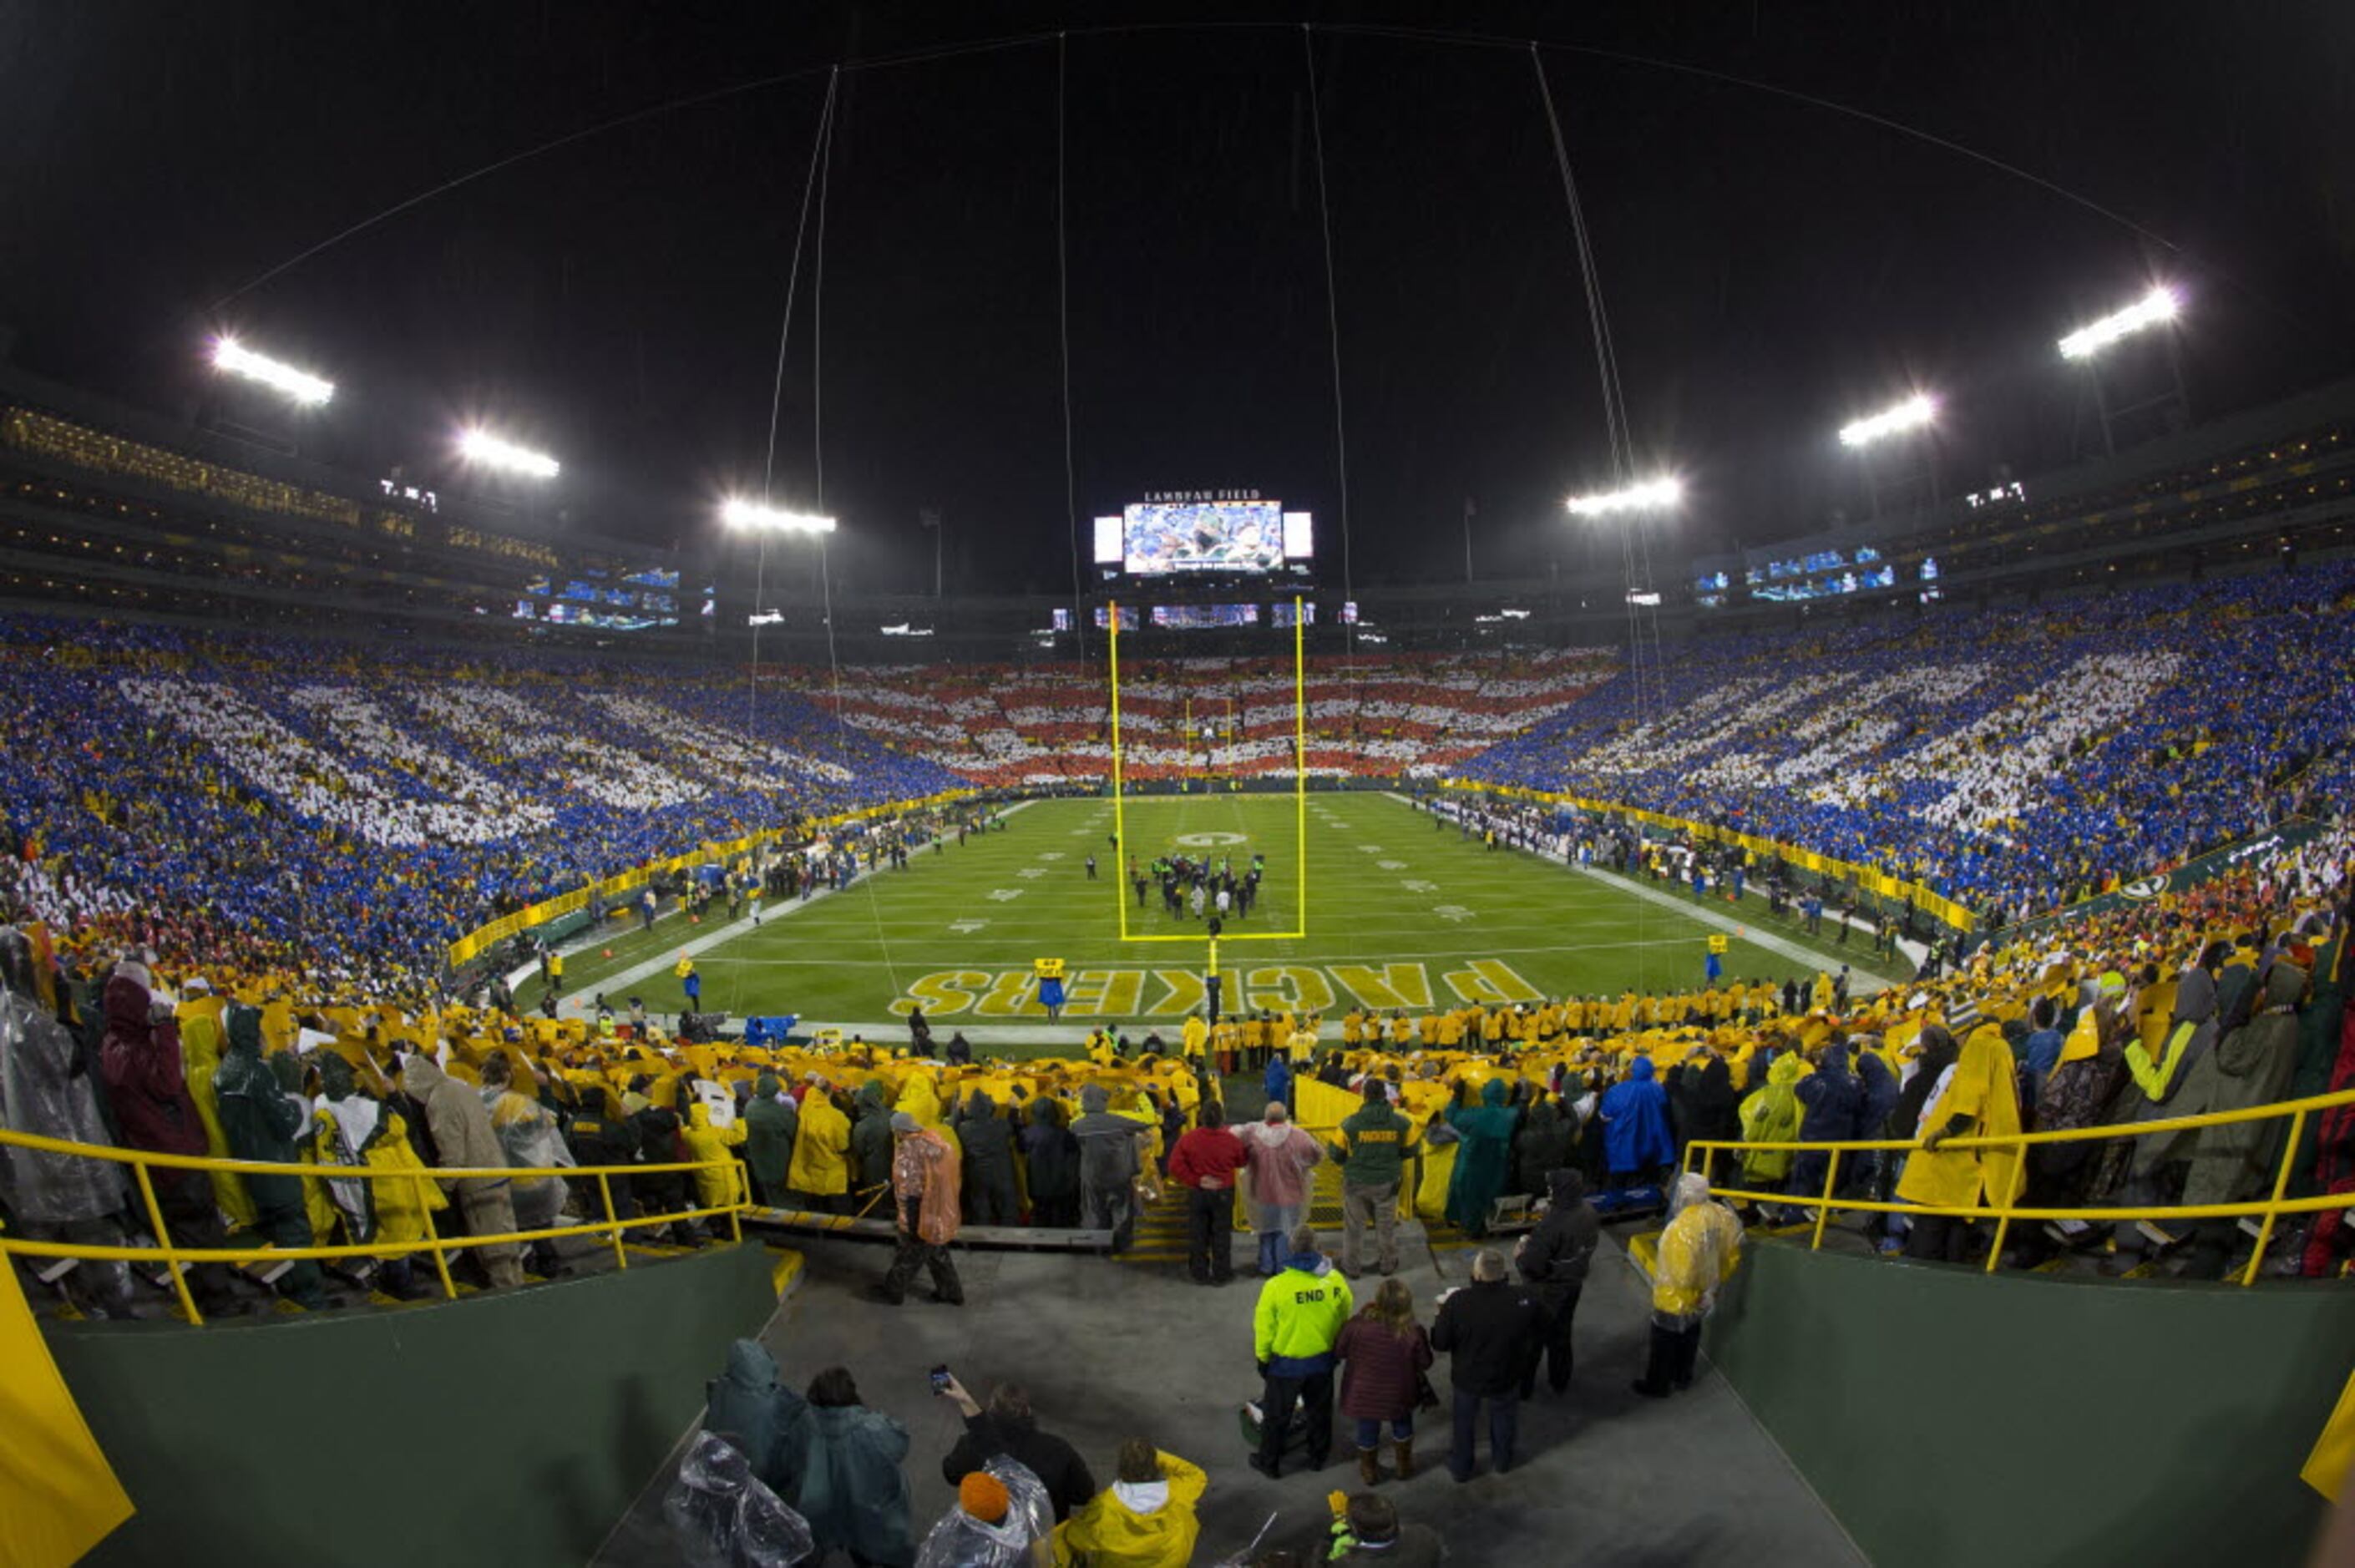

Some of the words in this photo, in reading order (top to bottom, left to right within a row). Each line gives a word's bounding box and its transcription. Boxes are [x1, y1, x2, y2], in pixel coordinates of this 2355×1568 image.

[1144, 491, 1213, 503] LAMBEAU
[1218, 489, 1260, 500] FIELD
[889, 959, 1547, 1017] PACKERS
[1295, 1290, 1324, 1304] END
